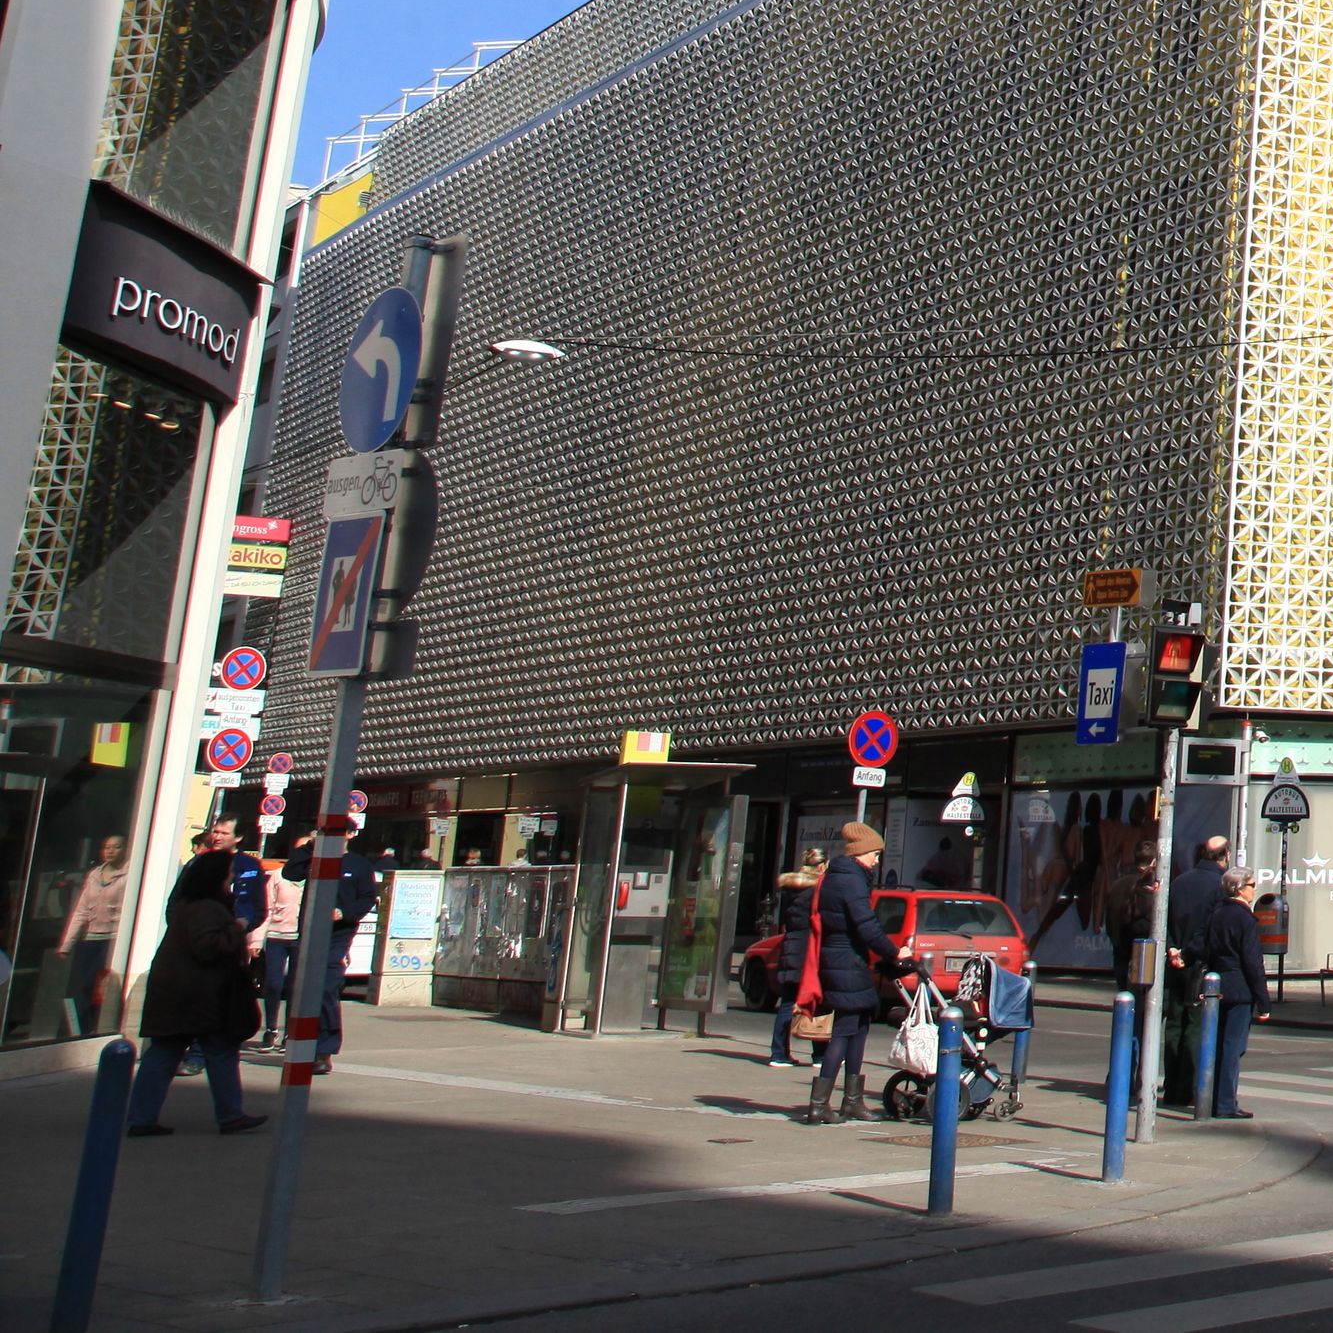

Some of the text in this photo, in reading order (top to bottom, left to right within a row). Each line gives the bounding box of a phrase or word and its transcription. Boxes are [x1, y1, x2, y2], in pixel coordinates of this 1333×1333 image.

[111, 276, 240, 364] promod
[327, 475, 361, 497] ausgen.
[233, 525, 268, 536] ngross
[229, 548, 283, 565] akiko
[1089, 680, 1115, 706] Taxi
[856, 770, 883, 784] Anfang
[1273, 787, 1300, 801] AUTOBUS
[1269, 806, 1303, 814] HALTESTELLE
